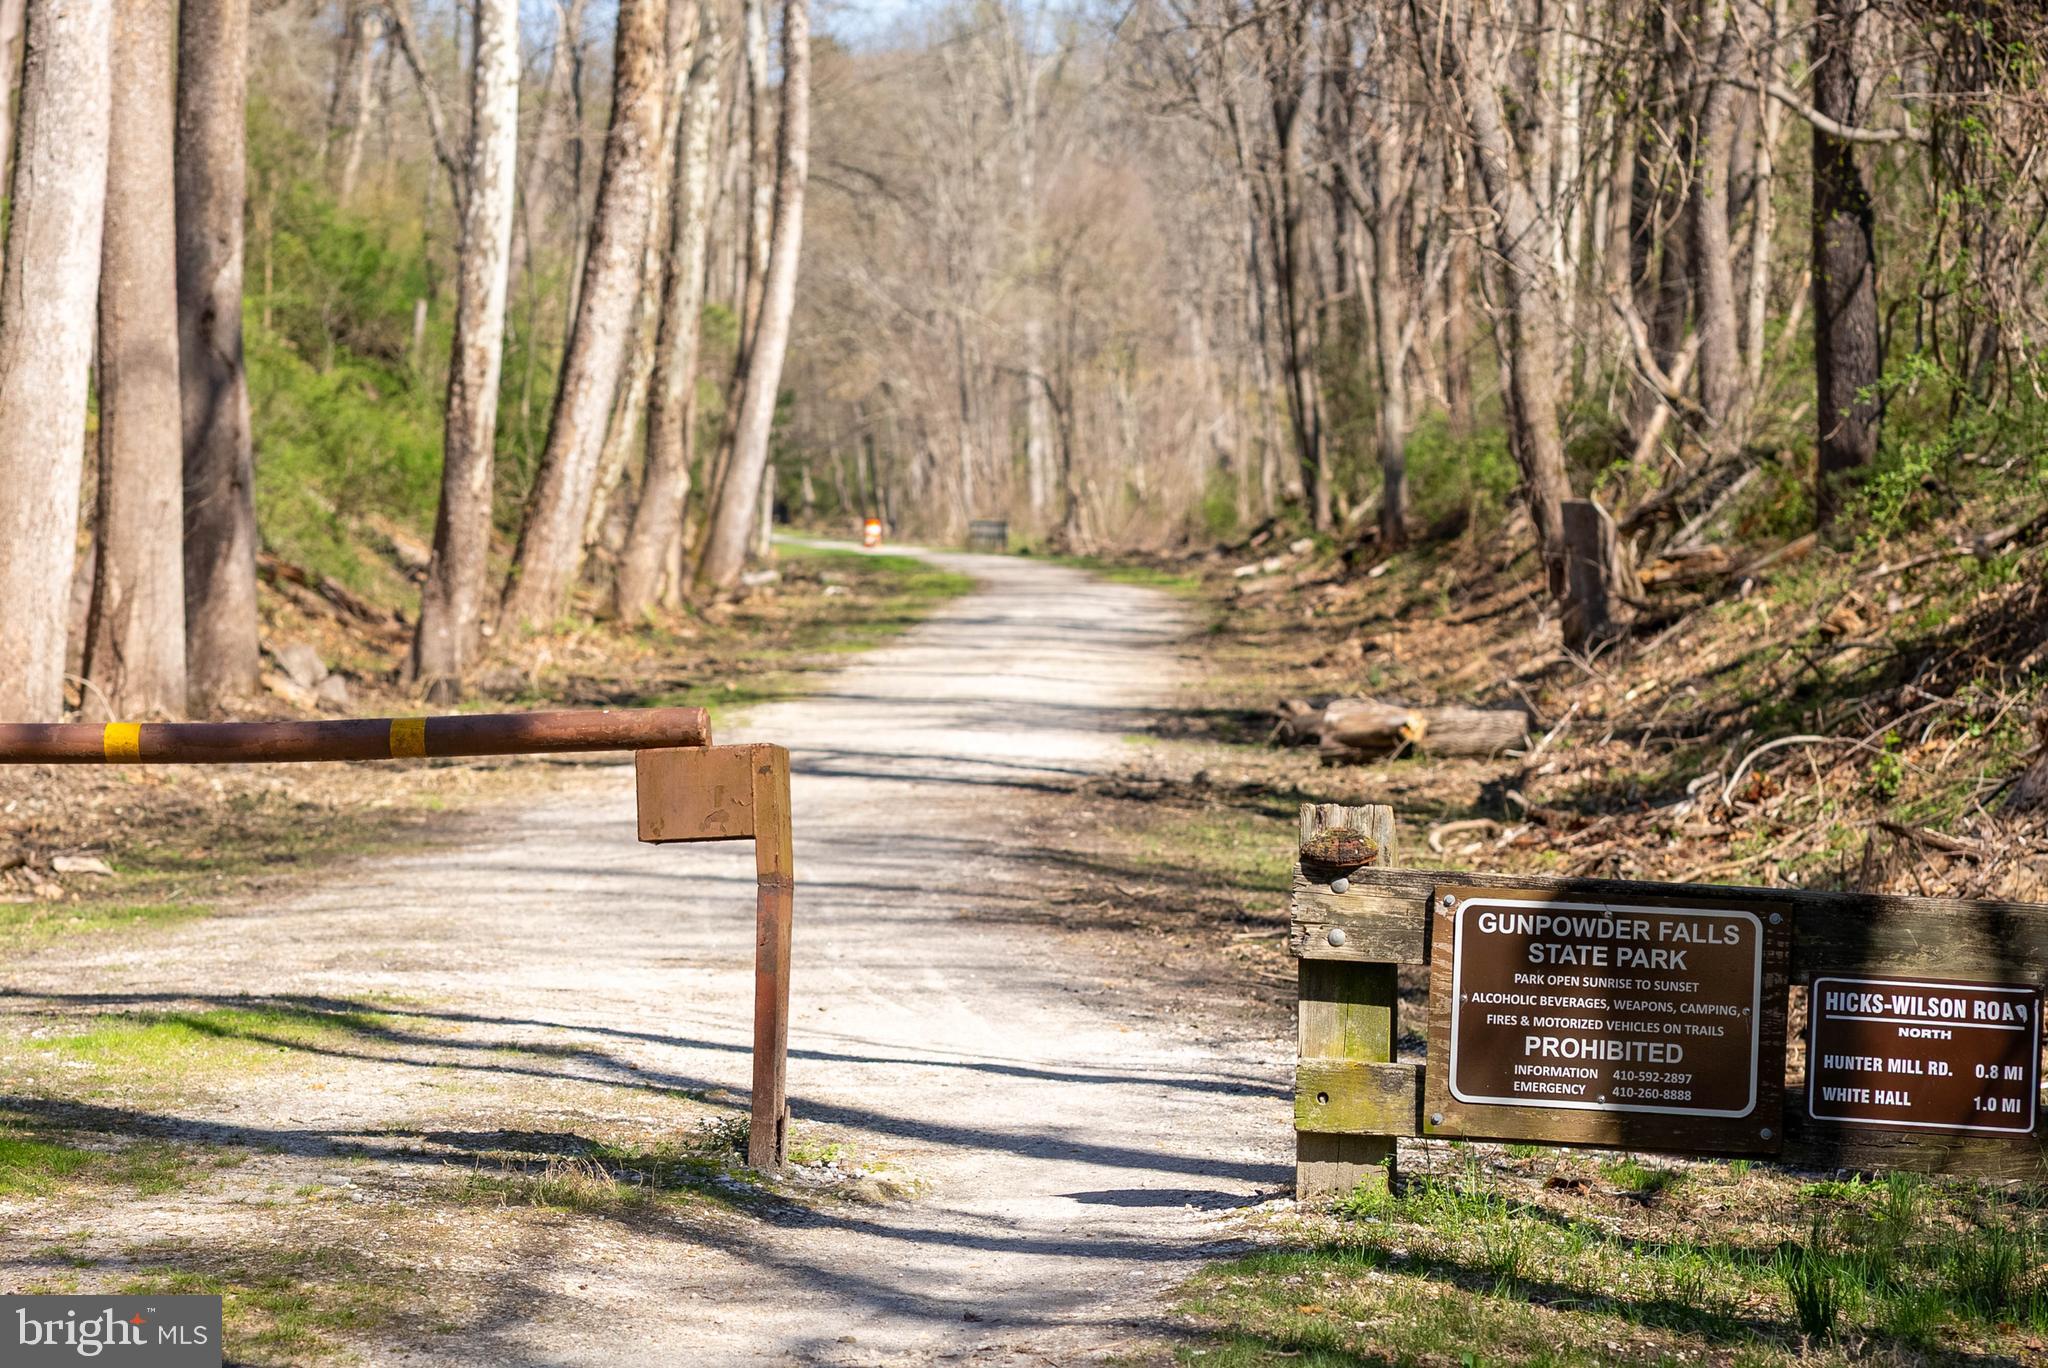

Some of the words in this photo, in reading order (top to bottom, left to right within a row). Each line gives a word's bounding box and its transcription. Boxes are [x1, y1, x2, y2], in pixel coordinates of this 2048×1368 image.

[1478, 912, 1651, 941] GUNPOWDER
[1659, 921, 1740, 945] FALLS
[1528, 943, 1608, 967] STATE
[1617, 950, 1688, 970] PARK
[1514, 973, 1544, 985] PARK
[1547, 975, 1580, 987] OPEN
[1582, 977, 1631, 989] SUNRISE
[1635, 979, 1650, 991] TO
[1654, 980, 1700, 993] SUNSET
[1472, 993, 1537, 1007] ALCOHOLIC
[1540, 996, 1610, 1011] BEVERAGES,
[1614, 1000, 1677, 1014] WEAPONS,
[1680, 1003, 1741, 1018] CAMPING,
[1826, 991, 1966, 1019] HICKS-WILSON
[1487, 1014, 1517, 1026] FIRES
[1520, 1016, 1530, 1027] &
[1533, 1017, 1603, 1031] MOTORIZED
[1606, 1021, 1660, 1034] VEHICLES
[1663, 1023, 1682, 1034] ON
[1684, 1024, 1724, 1037] TRAILS
[1898, 1027, 1952, 1040] NORTH
[1525, 1036, 1684, 1064] PROHIBITED
[1514, 1065, 1598, 1079] INFORMATION
[1613, 1070, 1692, 1084] 410-592-2897
[1824, 1055, 1883, 1072] HUNTER
[1888, 1058, 1923, 1074] MILL
[1928, 1061, 1952, 1076] RD.
[1975, 1064, 1999, 1079] 0.8
[2004, 1066, 2023, 1081] MI
[1513, 1081, 1586, 1095] EMERGENCY
[1612, 1087, 1692, 1101] 410-260-8888
[1822, 1087, 1869, 1104] WHITE
[1875, 1090, 1911, 1106] HALL
[1974, 1097, 1997, 1112] 1.0
[2002, 1098, 2020, 1113] MI
